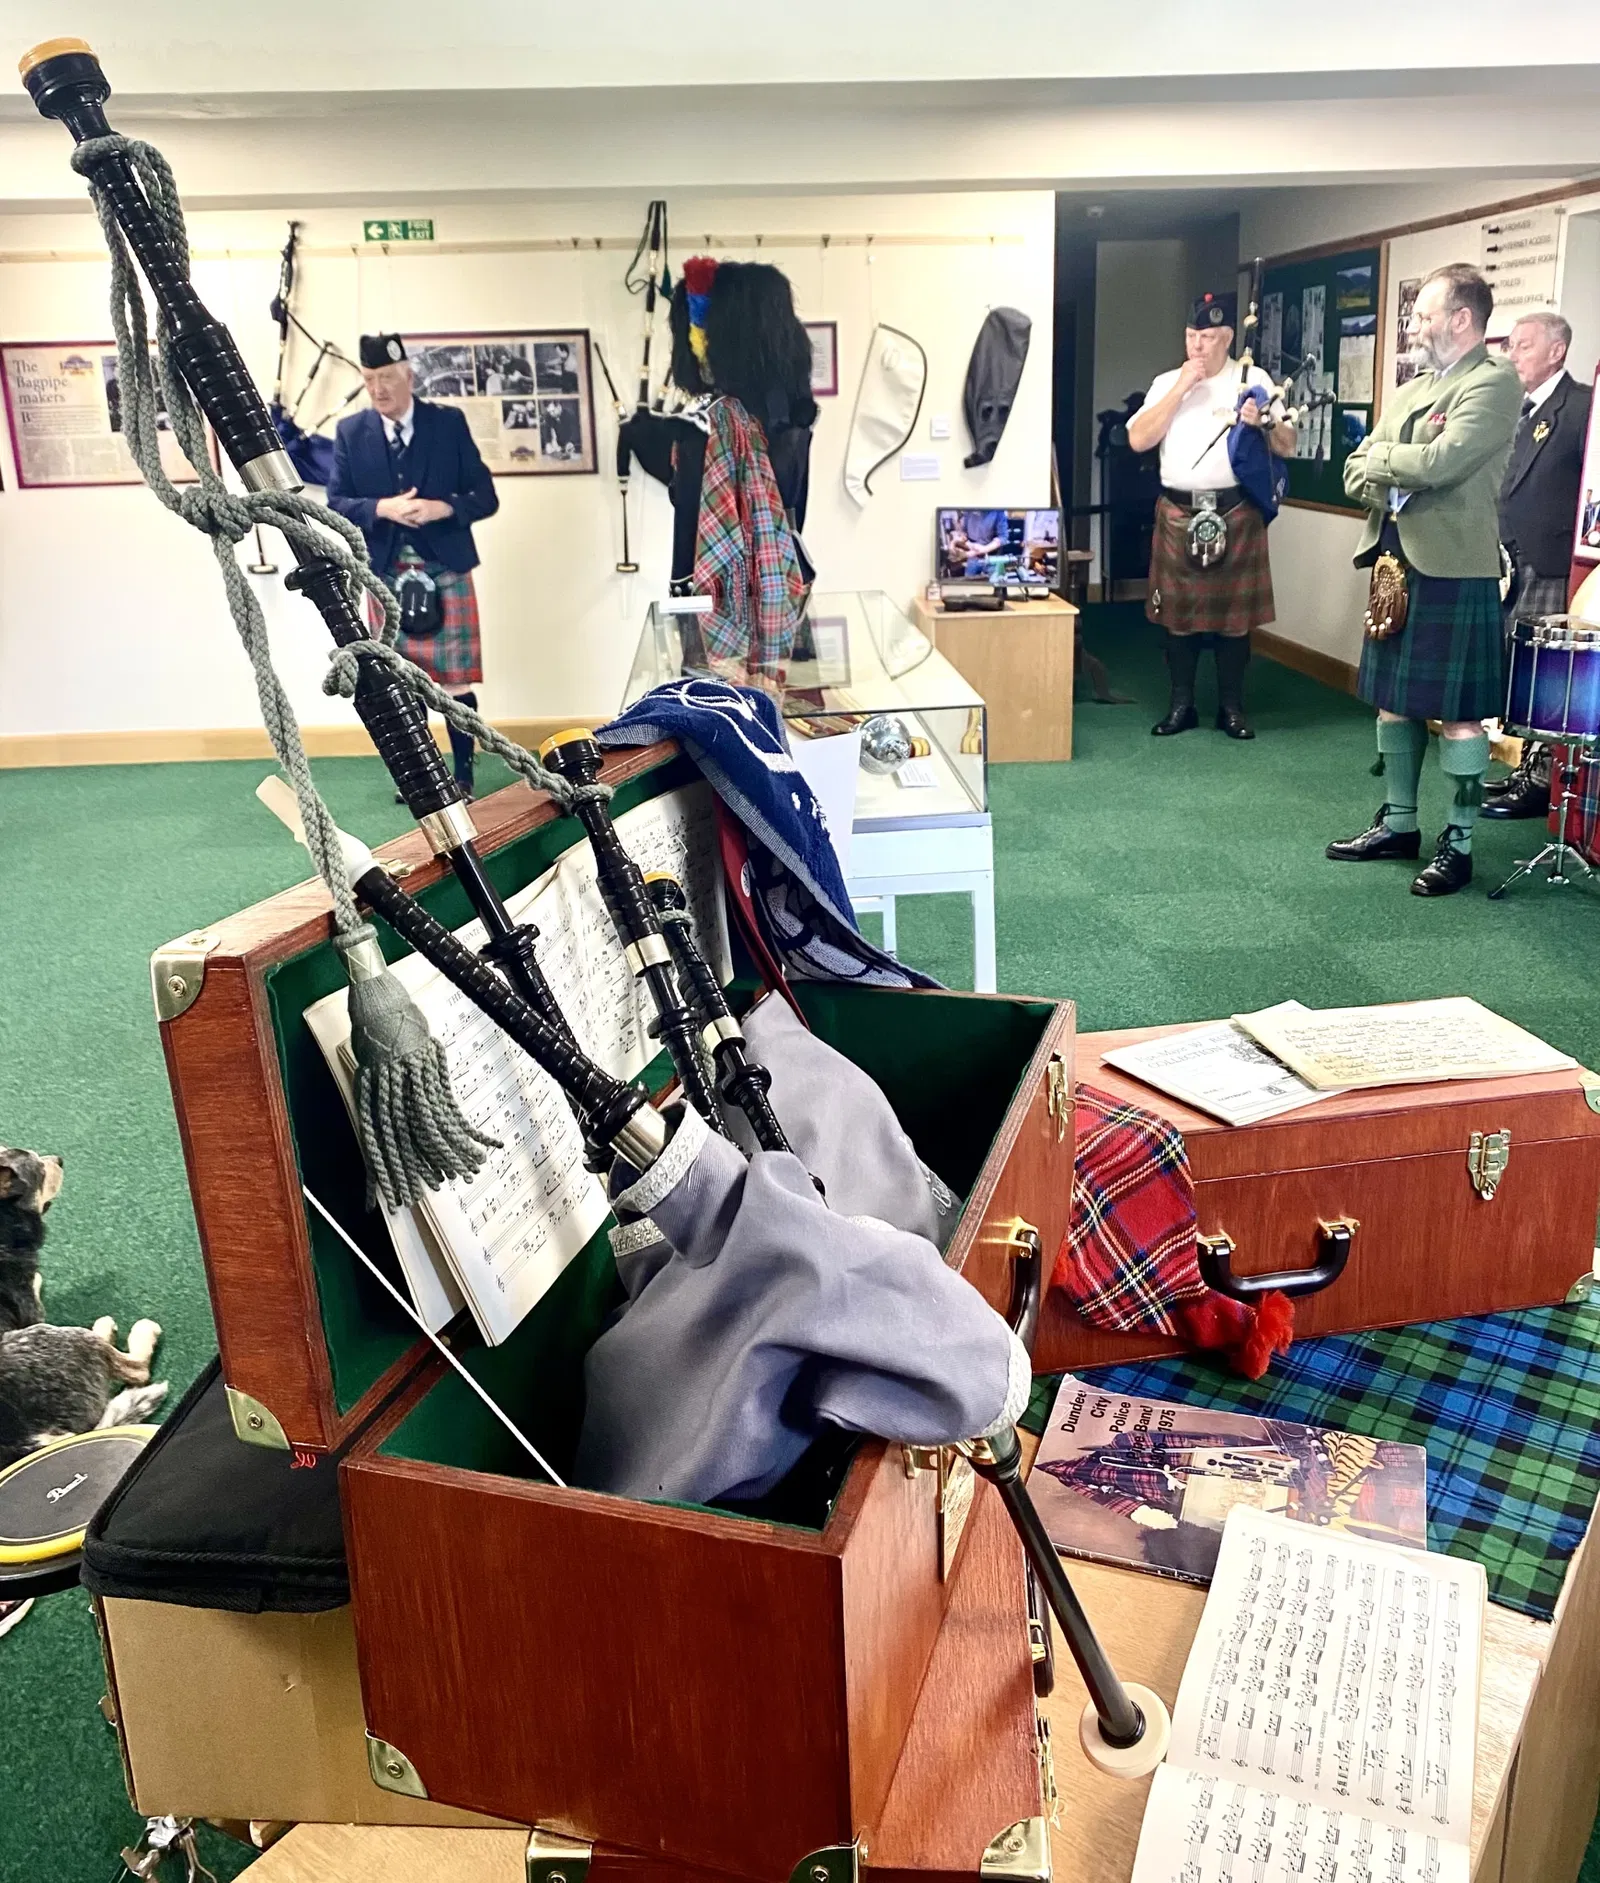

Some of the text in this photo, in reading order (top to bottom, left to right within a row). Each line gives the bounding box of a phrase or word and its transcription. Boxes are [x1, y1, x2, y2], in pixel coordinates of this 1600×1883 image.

[1500, 256, 1537, 269] CONFERENCE
[13, 359, 38, 373] The
[17, 376, 68, 393] Bagpipe
[19, 391, 66, 404] makers
[462, 926, 484, 943] CONTEN
[447, 990, 464, 1007] THE
[1147, 1045, 1225, 1069] COLLECTION
[1061, 1389, 1087, 1433] Dundee
[1090, 1395, 1112, 1418] City
[1109, 1401, 1132, 1433] Police
[1126, 1405, 1154, 1459] Pipe Band
[1157, 1409, 1176, 1432] 1975
[47, 1472, 88, 1504] Pearl
